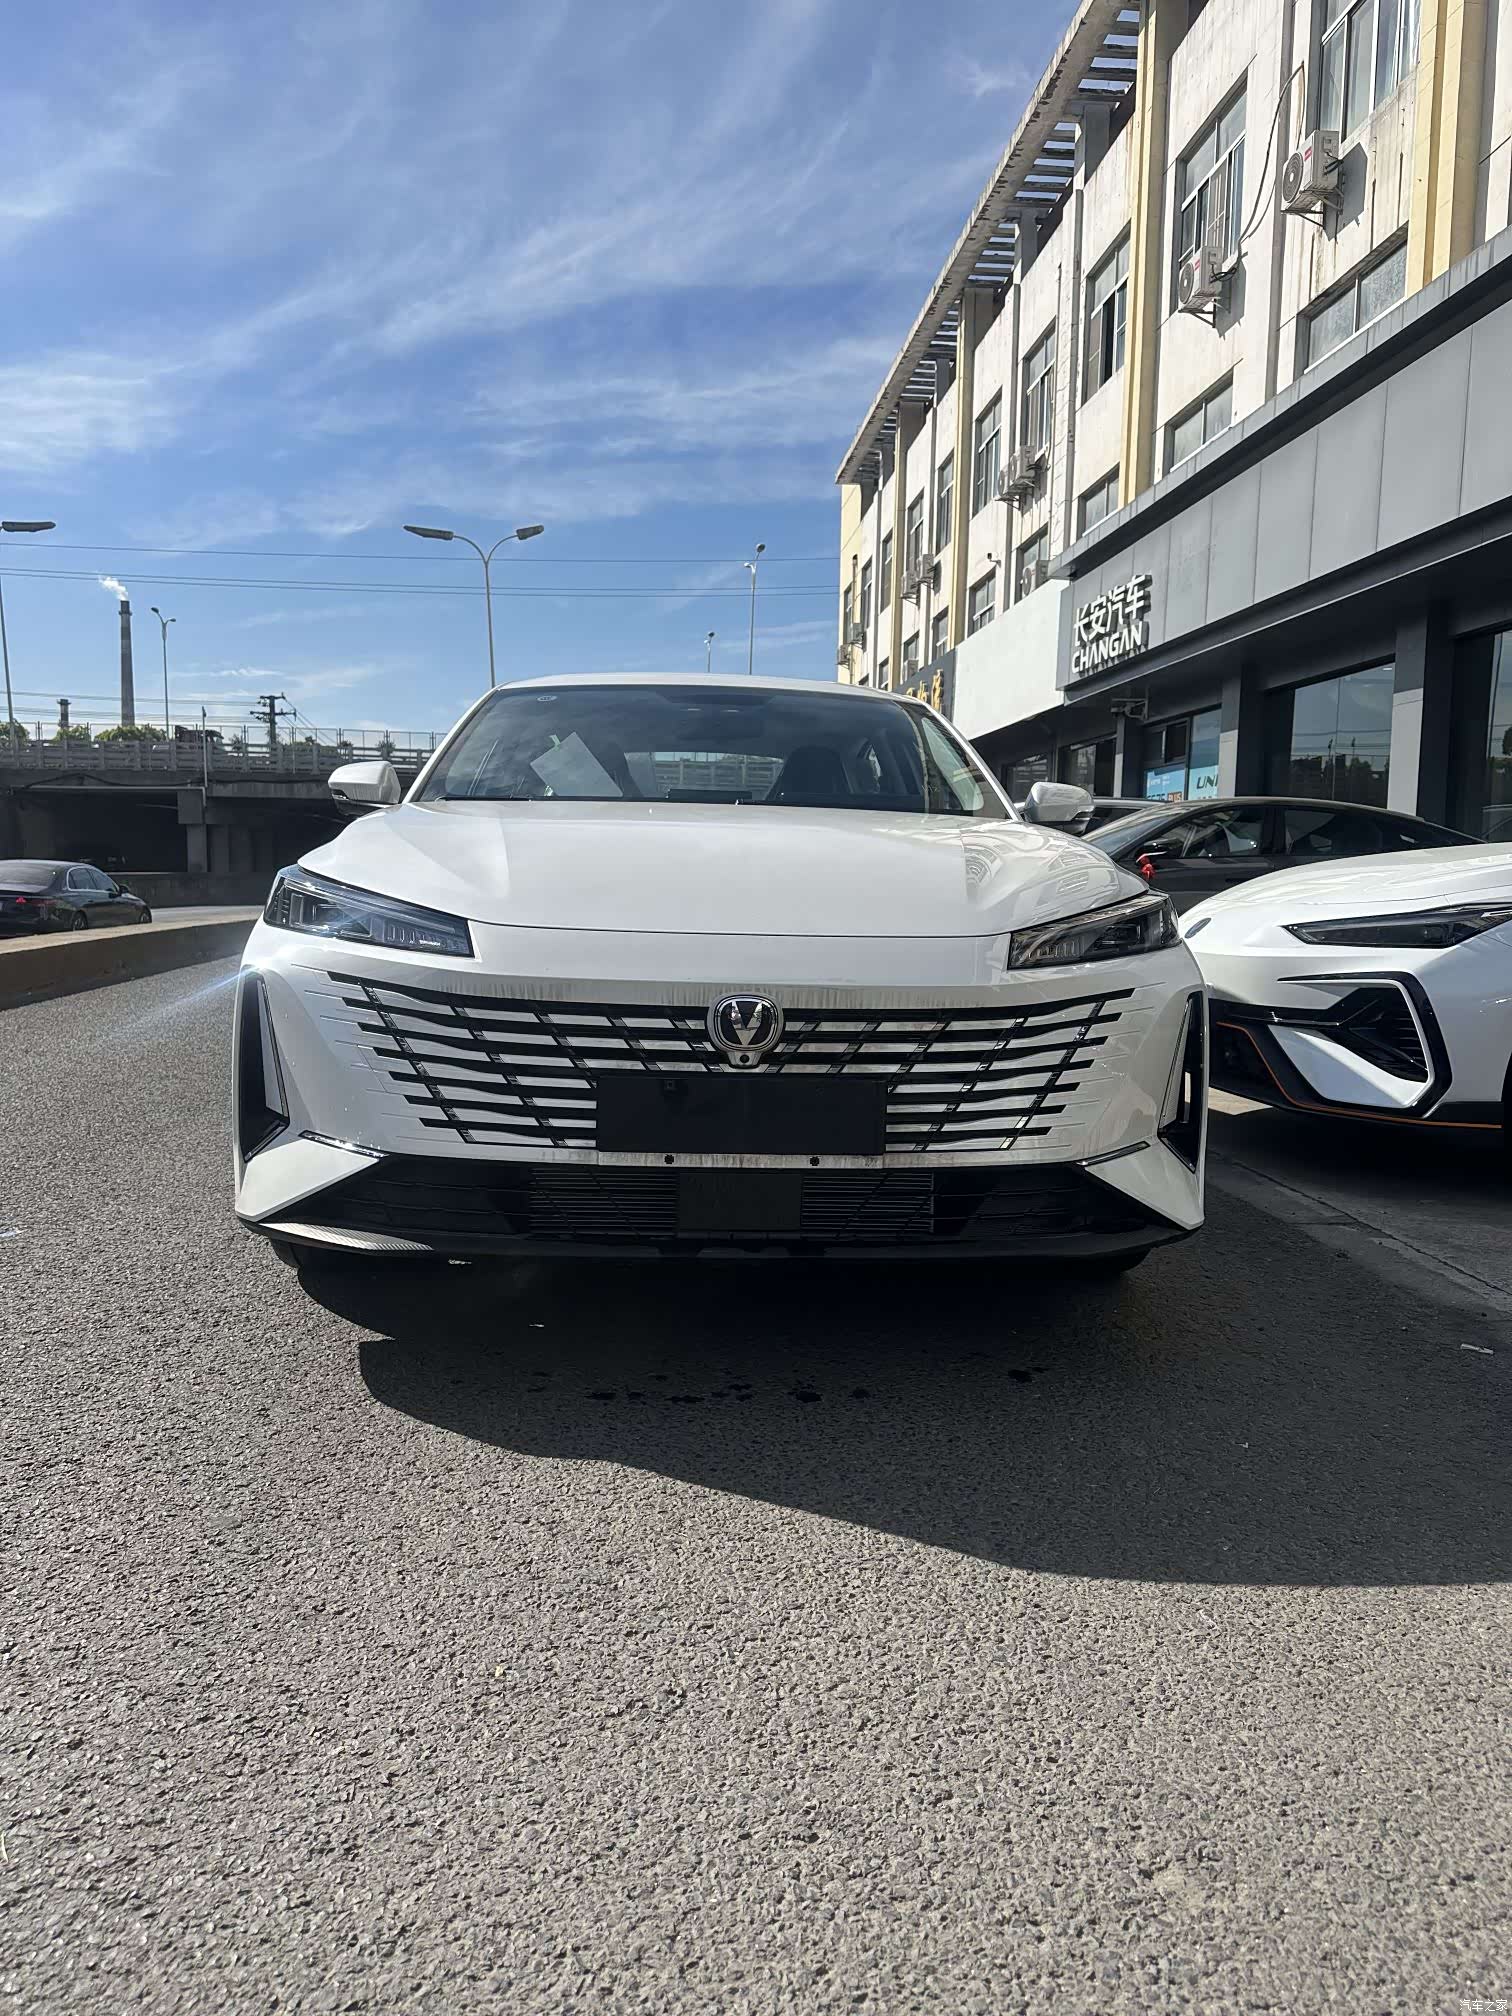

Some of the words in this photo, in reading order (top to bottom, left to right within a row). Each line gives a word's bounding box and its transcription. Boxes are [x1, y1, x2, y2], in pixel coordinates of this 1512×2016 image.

[1073, 574, 1145, 647] 长安汽车
[1072, 620, 1143, 674] CHANGAN
